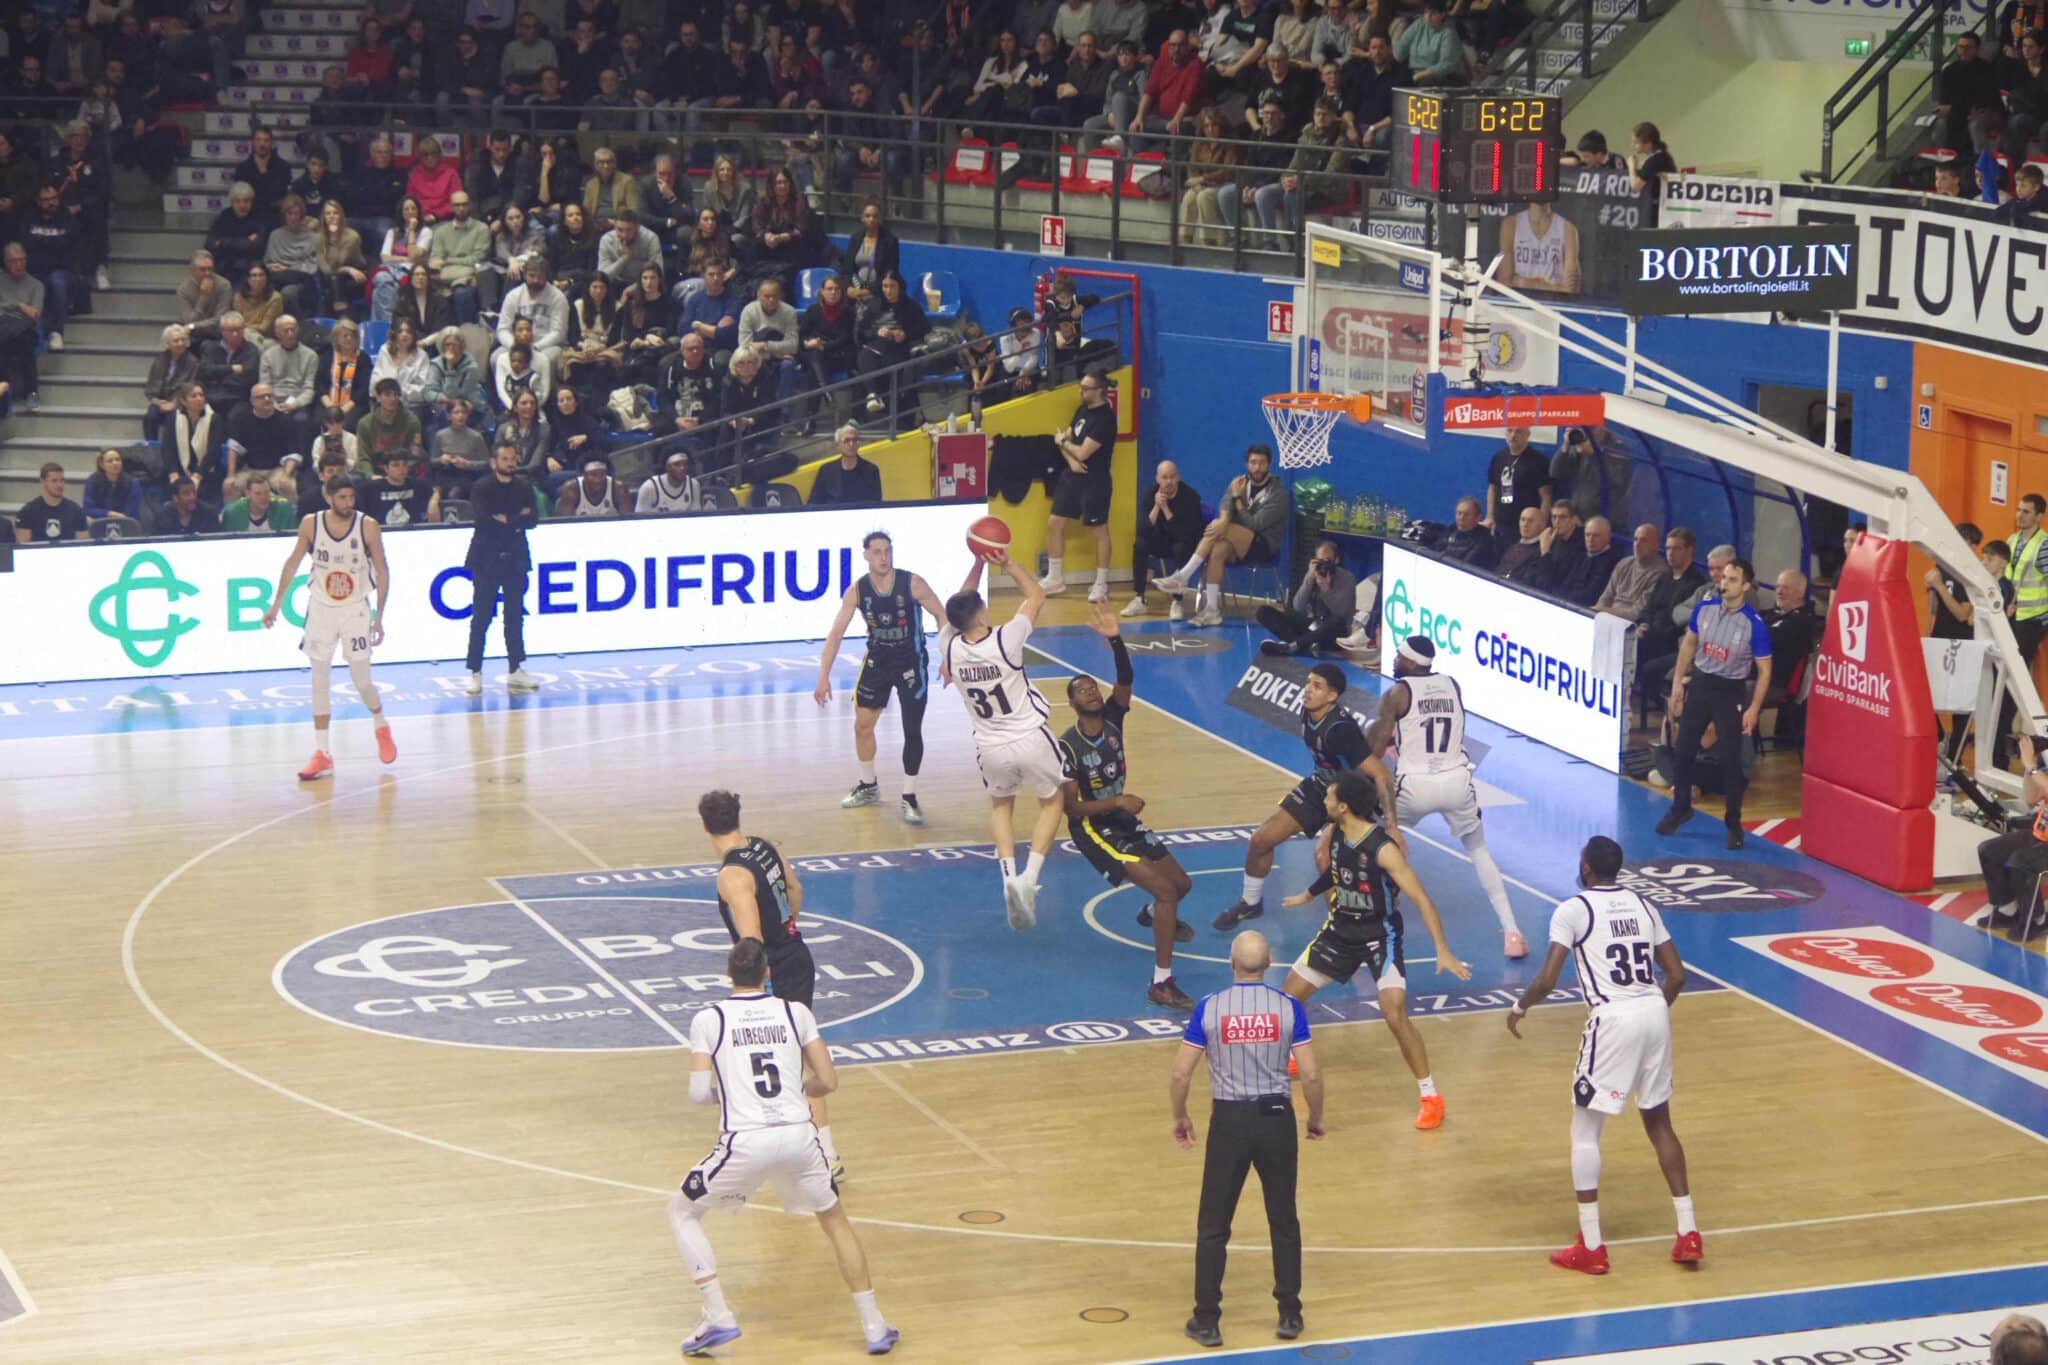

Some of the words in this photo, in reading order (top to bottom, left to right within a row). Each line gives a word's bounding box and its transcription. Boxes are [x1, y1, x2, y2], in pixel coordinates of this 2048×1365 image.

[1408, 96, 1439, 131] 6:22
[1480, 101, 1544, 132] 6:22
[1576, 172, 1600, 195] DA
[1666, 181, 1774, 206] ROCCIA
[1350, 221, 1440, 241] ATOTORIN
[1598, 205, 1640, 229] #20
[1404, 264, 1425, 287] Unipol
[1638, 243, 1852, 281] BORTOLIN
[1797, 208, 2046, 336] IOVE
[1679, 279, 1810, 295] www.bortolingioielli.it
[1471, 407, 1504, 422] Bank
[351, 636, 367, 651] 20
[1419, 606, 1463, 656] BCC
[958, 663, 1003, 683] CALZAVARA
[1237, 664, 1304, 715] POKER
[1474, 629, 1619, 718] CREDIFRIULI
[1815, 653, 1891, 703] CiviBank
[966, 683, 1013, 719] 31
[1814, 684, 1845, 703] GRUPPO
[1846, 691, 1891, 718] SPARKASSE
[1419, 716, 1453, 754] 17
[1614, 868, 1701, 907] NERGY
[1639, 863, 1778, 900] SKY
[1609, 917, 1640, 938] IKANGI
[1605, 941, 1655, 987] 35
[1802, 937, 1907, 979] Delser
[493, 1006, 634, 1026] GRUPPO
[1227, 1014, 1274, 1030] ATTAL
[1905, 983, 2016, 1029] Delser
[731, 1024, 788, 1048] ALIBEGOVIC
[827, 1030, 1041, 1062] Allianz
[1227, 1028, 1274, 1039] GROUP
[749, 1051, 783, 1099] 5
